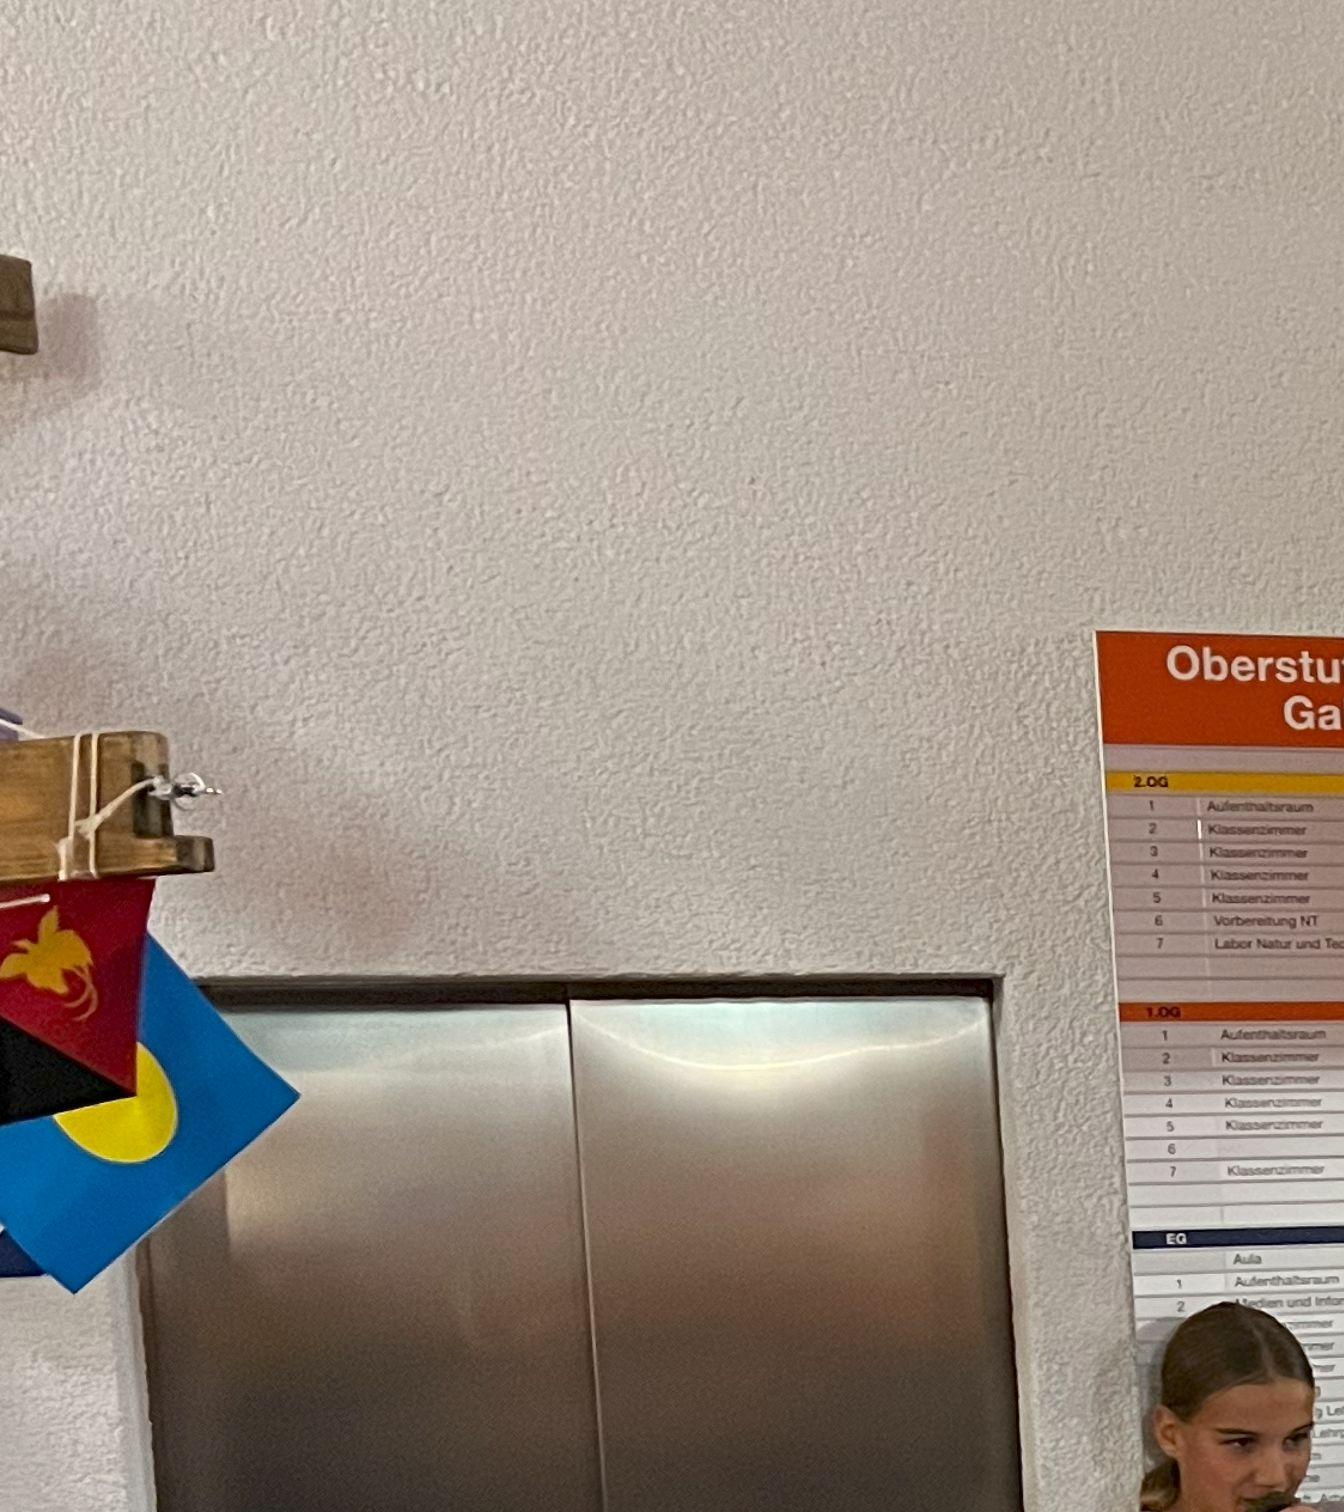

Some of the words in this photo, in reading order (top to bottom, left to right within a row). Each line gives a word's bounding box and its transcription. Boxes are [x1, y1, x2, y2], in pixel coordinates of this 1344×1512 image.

[1134, 775, 1169, 789] 2.OG
[1149, 823, 1157, 834] 2
[1208, 824, 1307, 836] Klassenzimmer
[1150, 846, 1159, 857] 3
[1210, 847, 1308, 859] Klassenzimmer
[1151, 869, 1159, 880] 4
[1211, 869, 1309, 881] Klassenzimmer
[1153, 892, 1161, 904] 5
[1212, 892, 1311, 904] Klassenzimmer
[1155, 915, 1163, 926] 6
[1214, 914, 1297, 929] Vorbereitung
[1301, 915, 1319, 926] NT
[1156, 937, 1164, 949] 7
[1214, 938, 1252, 950] Labor
[1256, 938, 1292, 950] Natur
[1295, 938, 1322, 950] und
[1162, 1053, 1170, 1064] 2
[1221, 1051, 1320, 1063] Klassenzimmer
[1164, 1075, 1172, 1087] 3
[1222, 1074, 1320, 1086] Klassenzimmer
[1165, 1098, 1173, 1109] 4
[1224, 1097, 1322, 1109] Klassenzimmer
[1167, 1121, 1175, 1132] 5
[1225, 1119, 1323, 1131] Klassenzimmer
[1167, 1144, 1176, 1155] 6
[1227, 1164, 1325, 1176] Klassenzimmer
[1165, 1232, 1187, 1245] EG
[1233, 1253, 1262, 1265] Aula
[1176, 1301, 1185, 1312] 2
